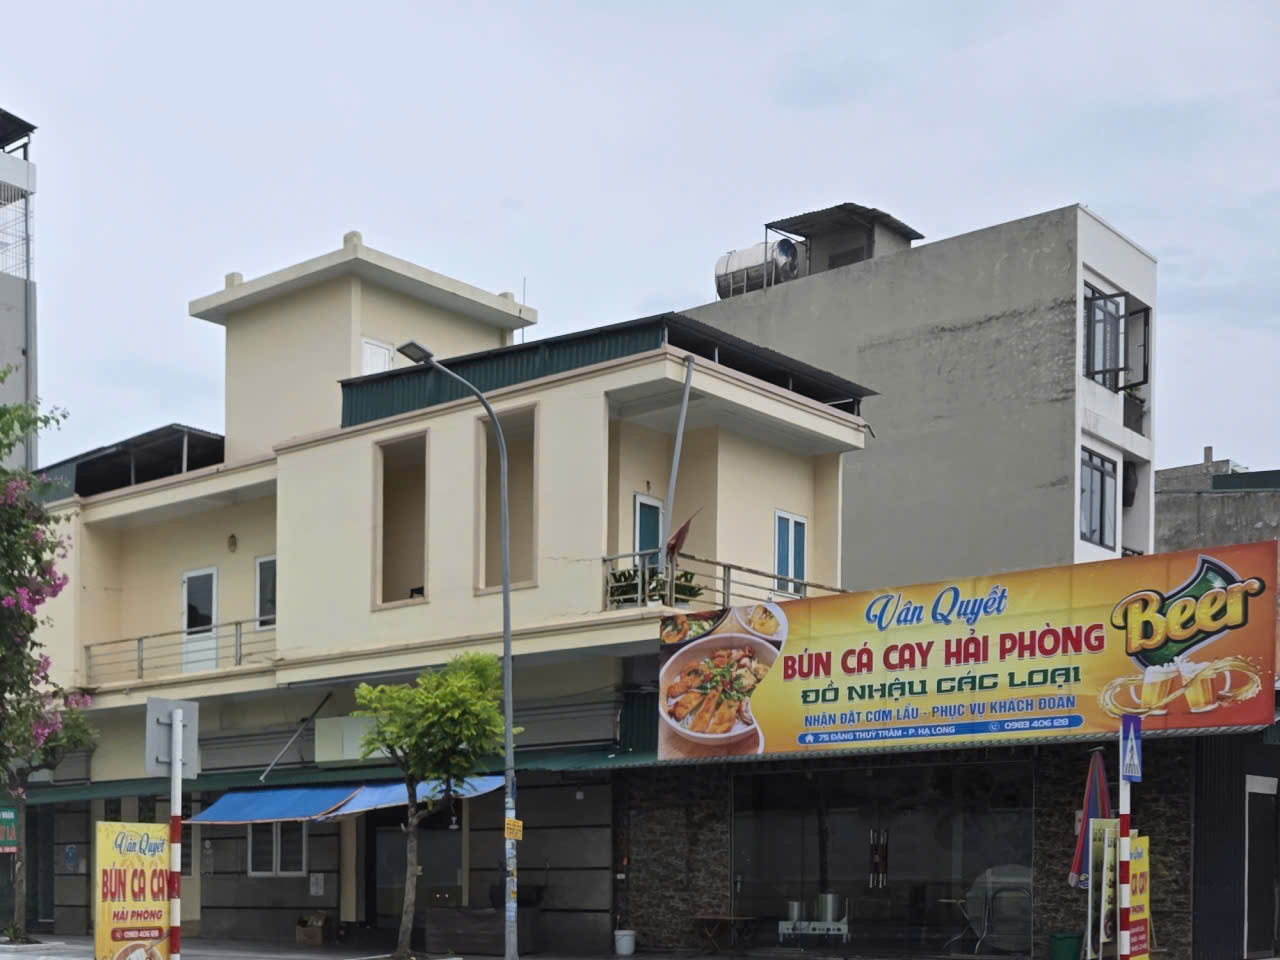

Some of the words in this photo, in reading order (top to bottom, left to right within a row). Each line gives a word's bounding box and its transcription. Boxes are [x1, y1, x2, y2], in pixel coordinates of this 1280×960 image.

[865, 593, 924, 631] Vân
[931, 585, 1008, 625] Quyết
[1111, 577, 1265, 656] Beer
[783, 648, 832, 680] BÚN
[841, 642, 873, 675] CÁ
[883, 640, 935, 672] CAY
[944, 628, 989, 666] HẢI
[999, 623, 1105, 662] PHÒNG
[801, 680, 839, 704] ĐỒ
[847, 677, 928, 701] NHẬU
[936, 670, 999, 694] CÁC
[1008, 665, 1081, 688] LOẠI
[804, 711, 836, 729] NHẬN
[840, 709, 862, 727] ĐẶT
[865, 708, 892, 723] CƠM
[932, 704, 965, 719] PHỤC
[970, 702, 986, 718] VỤ
[990, 697, 1034, 714] KHÁCH
[1038, 694, 1076, 711] ĐOÀN
[918, 727, 931, 736] HẠ
[932, 725, 955, 734] LONG
[1031, 720, 1052, 728] 406
[101, 862, 127, 901] BÚN
[131, 862, 146, 901] CÁ
[150, 868, 170, 901] CAY
[112, 908, 128, 921] HẢI
[131, 908, 163, 921] PHÒNG
